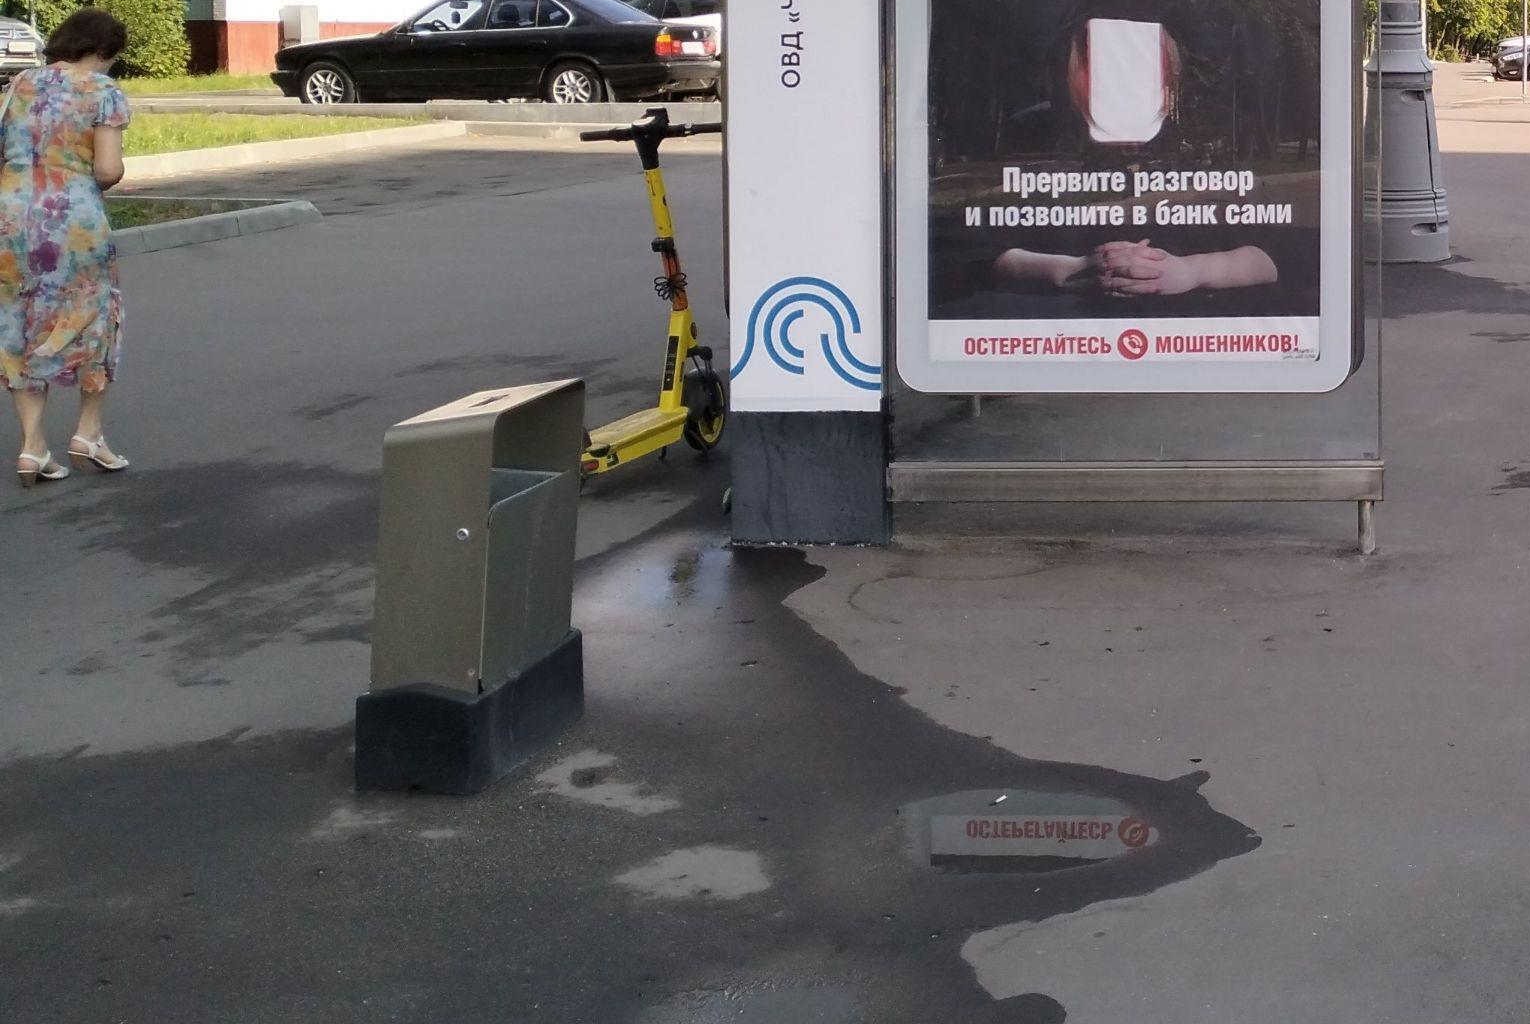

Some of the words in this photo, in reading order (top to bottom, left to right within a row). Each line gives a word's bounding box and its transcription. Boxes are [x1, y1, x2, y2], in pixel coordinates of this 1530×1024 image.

[781, 31, 804, 88] ОВД
[1003, 166, 1126, 198] Прервите
[1134, 169, 1254, 197] разговор
[965, 206, 981, 226] и
[989, 204, 1125, 226] позвоните
[1132, 205, 1147, 225] в
[1155, 199, 1217, 225] банк
[1225, 203, 1292, 224] сами
[964, 332, 1112, 355] ОСТЕРЕГАЙТЕСЬ
[1155, 334, 1299, 353] МОШЕННИКОВ!
